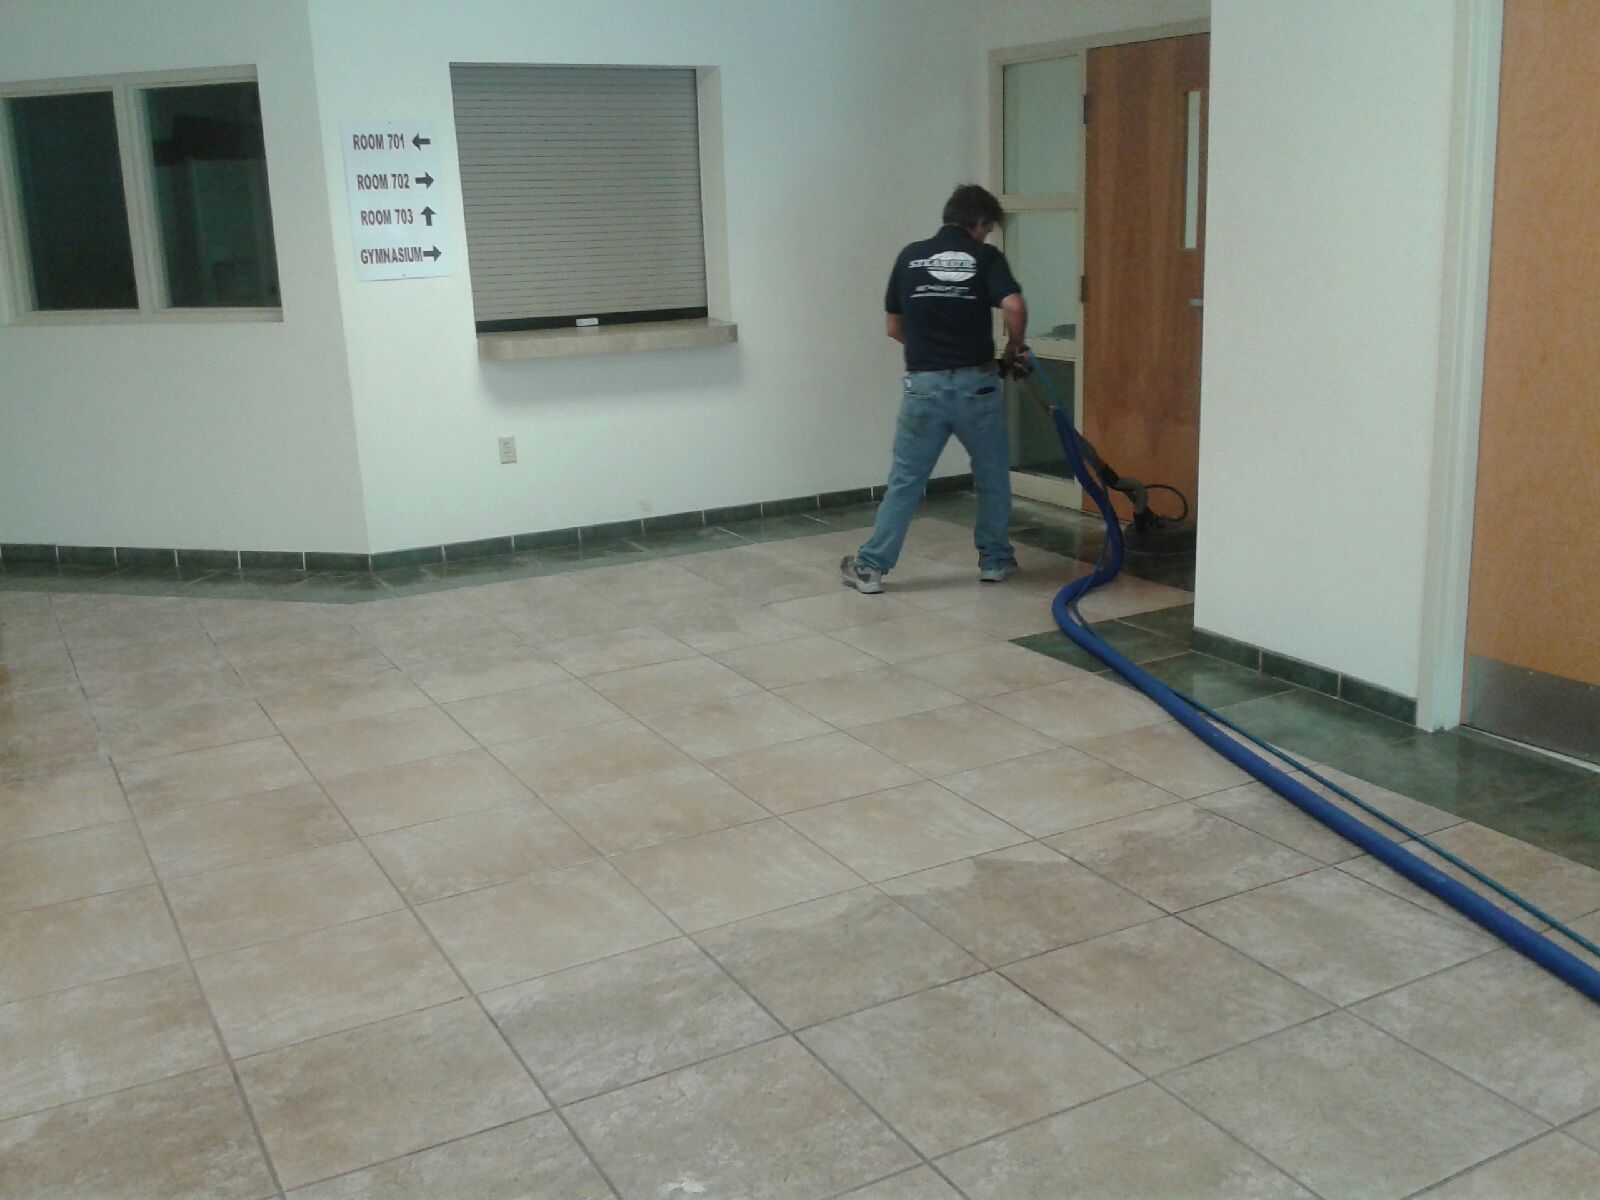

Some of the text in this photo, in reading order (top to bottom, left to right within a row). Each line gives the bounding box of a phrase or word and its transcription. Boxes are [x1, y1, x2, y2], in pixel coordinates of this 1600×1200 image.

[353, 133, 405, 150] ROOM 701
[357, 173, 410, 190] ROOM 702
[361, 208, 413, 226] ROOM 703
[361, 247, 423, 264] GYMNASIUM
